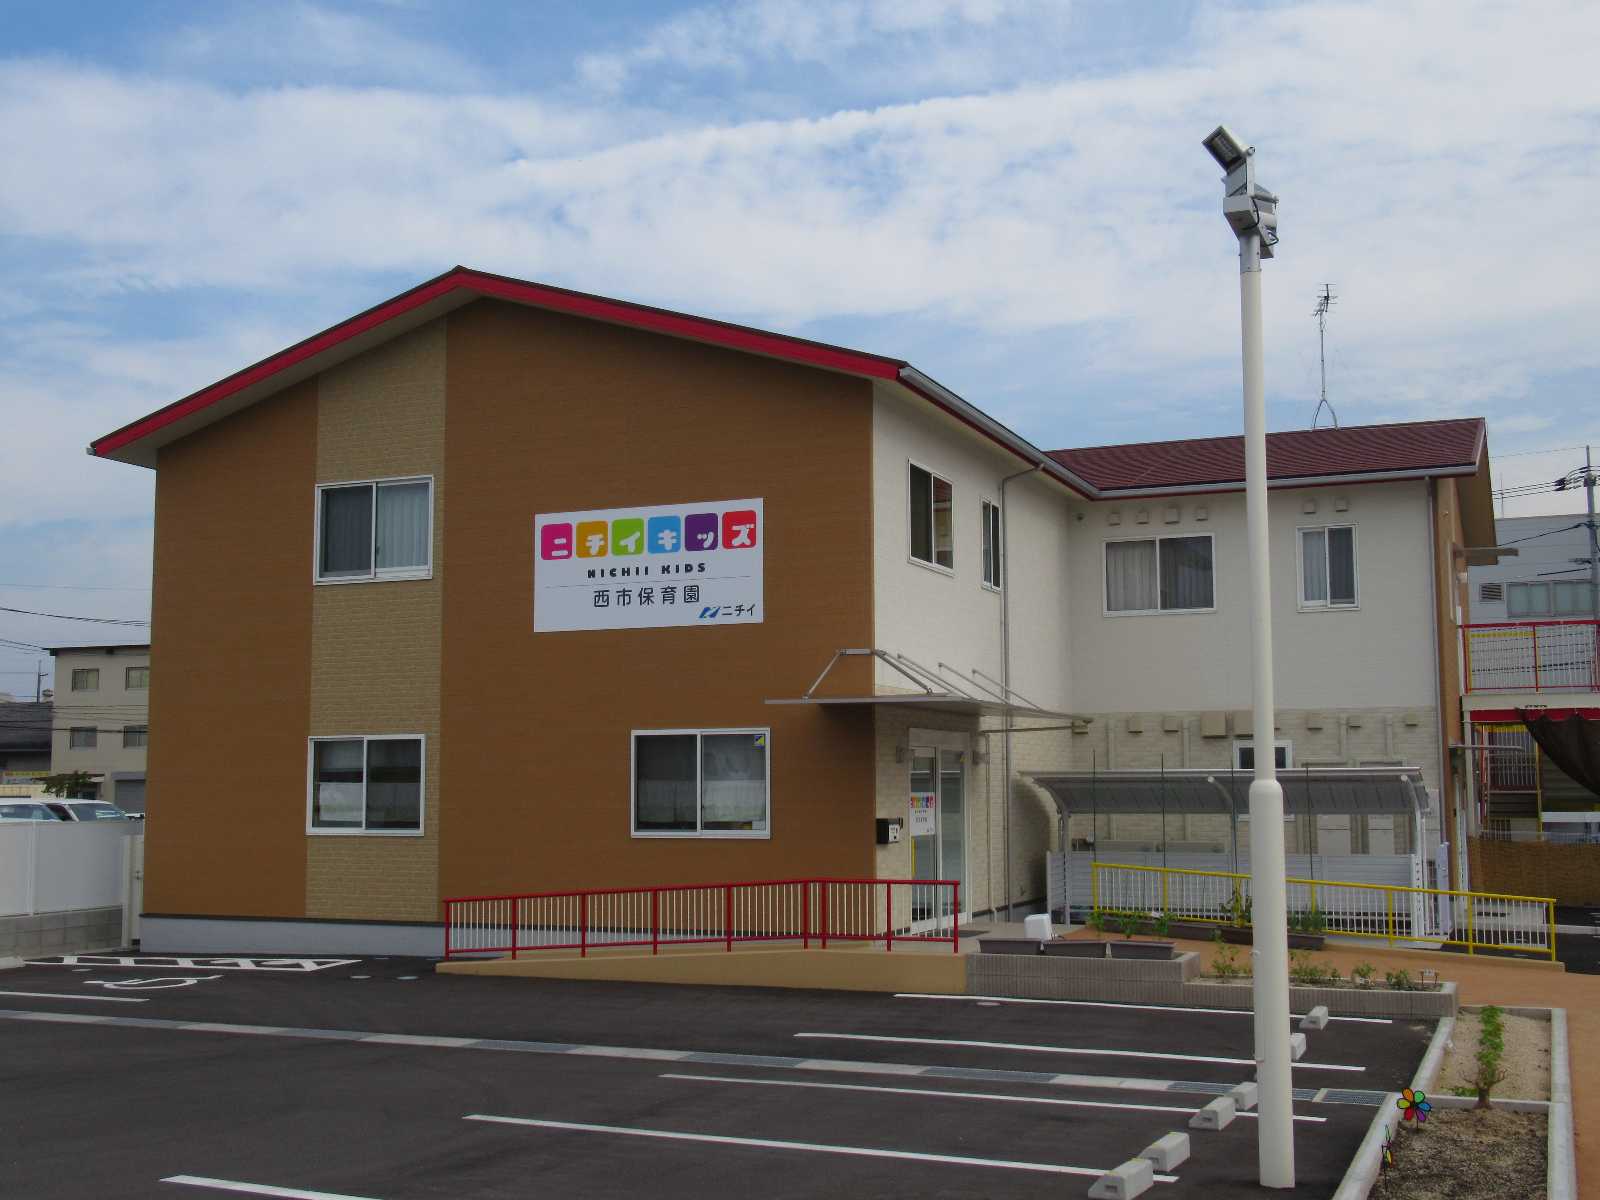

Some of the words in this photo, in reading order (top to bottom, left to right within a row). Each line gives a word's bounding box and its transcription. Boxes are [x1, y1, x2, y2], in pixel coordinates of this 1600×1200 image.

[550, 522, 756, 558] ニチイキッズ
[587, 566, 650, 579] NICHII
[661, 562, 706, 575] KIDS
[593, 585, 700, 608] 西市保育園
[721, 603, 757, 617] ニチイ
